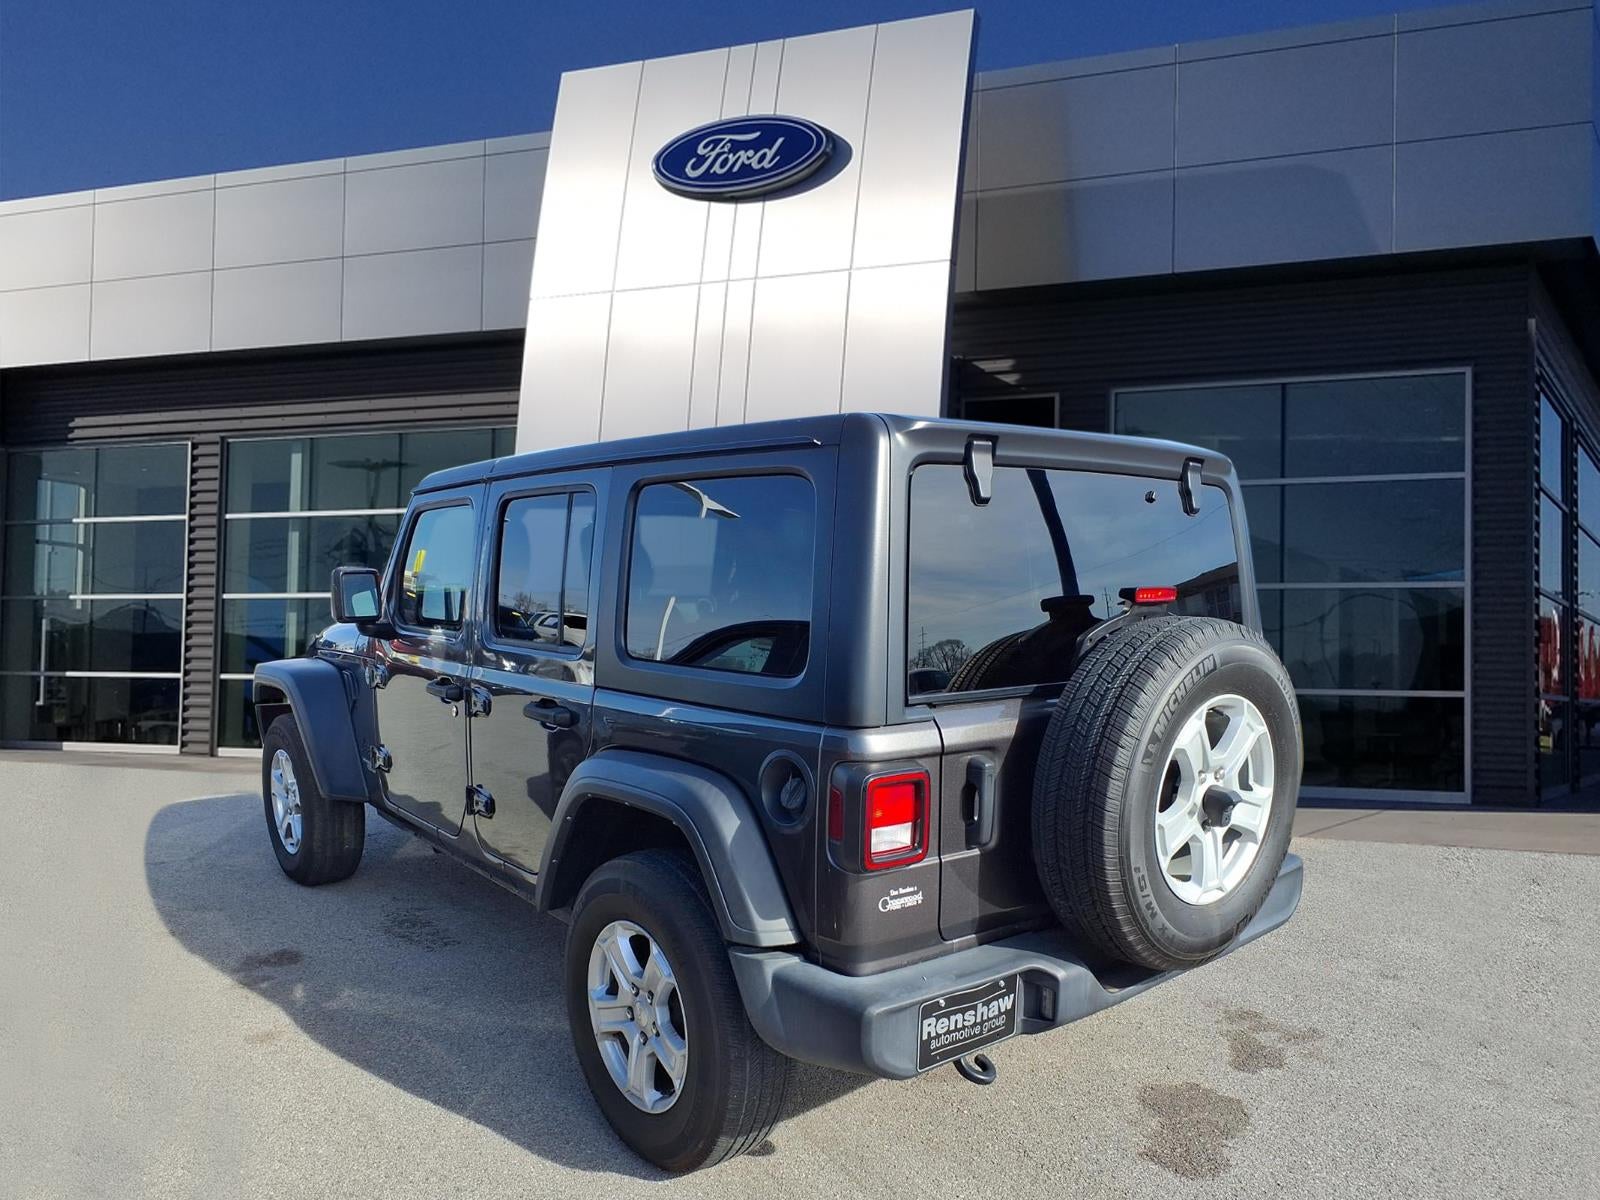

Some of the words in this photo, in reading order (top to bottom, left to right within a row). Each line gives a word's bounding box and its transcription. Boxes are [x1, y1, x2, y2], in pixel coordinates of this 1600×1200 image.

[685, 131, 785, 178] Ford
[1154, 654, 1217, 740] MICHELIN
[922, 993, 1015, 1041] Renshaw
[930, 1025, 981, 1050] automotive
[982, 1014, 1006, 1034] group
